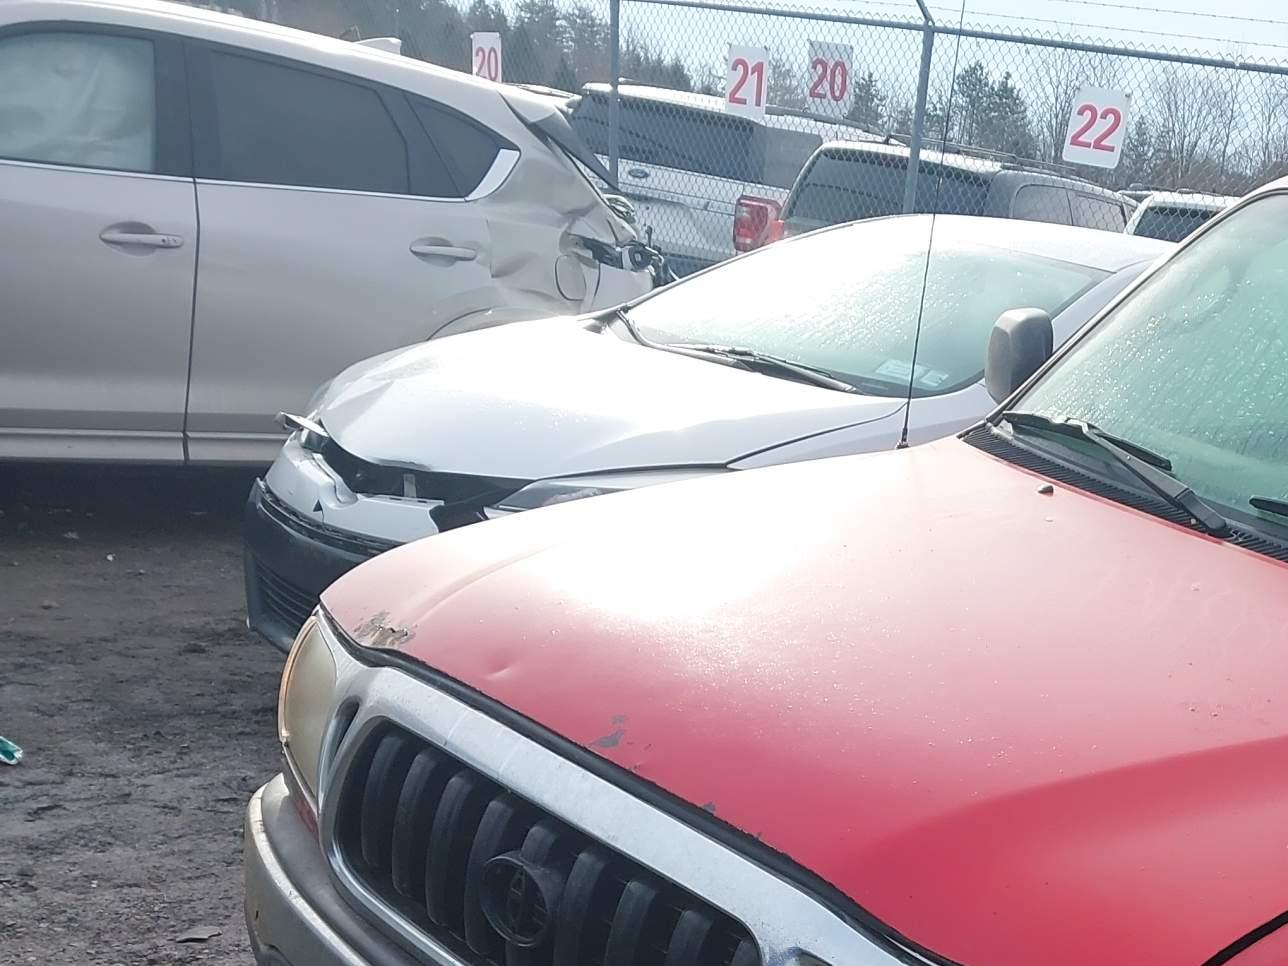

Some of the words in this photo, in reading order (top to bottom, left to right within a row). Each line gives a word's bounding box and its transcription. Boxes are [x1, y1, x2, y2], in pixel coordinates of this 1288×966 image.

[475, 46, 499, 81] 20
[728, 58, 764, 107] 21
[809, 58, 848, 102] 20
[1069, 103, 1122, 152] 22
